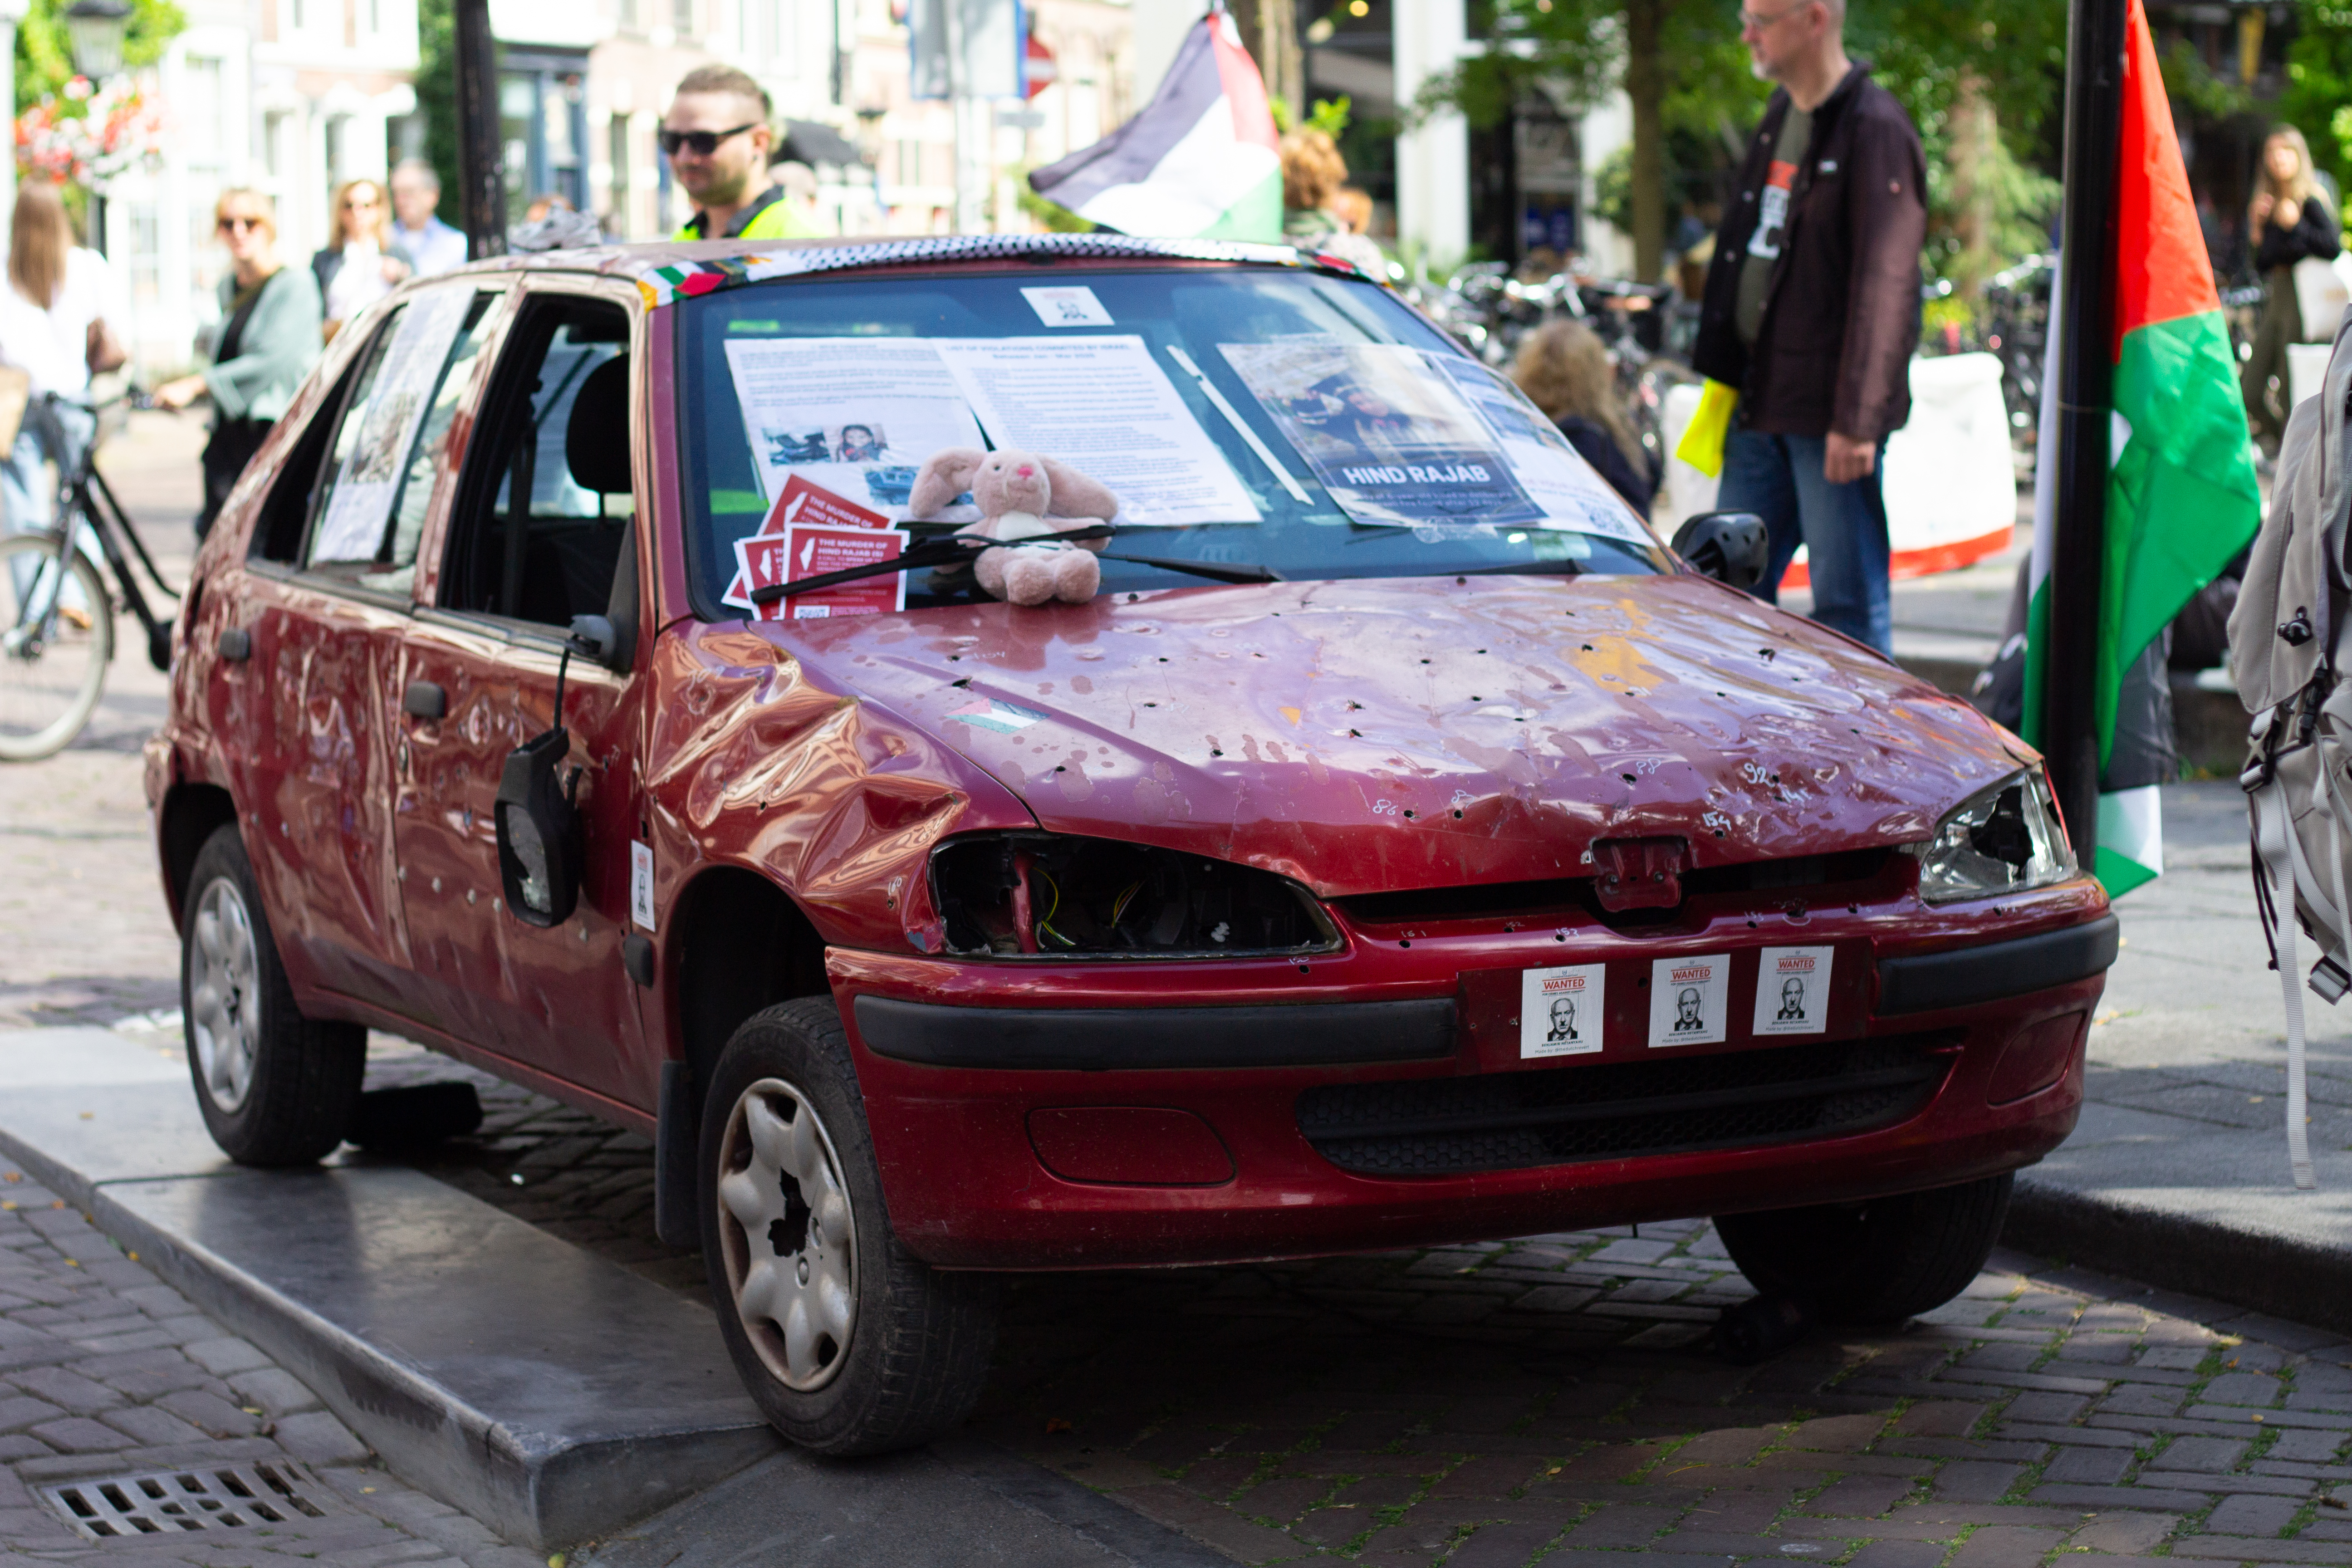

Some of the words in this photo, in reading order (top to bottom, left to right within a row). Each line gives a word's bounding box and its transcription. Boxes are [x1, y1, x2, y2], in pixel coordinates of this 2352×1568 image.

[1343, 466, 1407, 484] HIND
[1407, 464, 1490, 483] RAJAB
[810, 495, 826, 510] THE
[826, 504, 861, 524] MURDER
[819, 539, 836, 547] THE
[837, 539, 875, 548] MURDER
[818, 548, 841, 556] HIND
[842, 549, 871, 557] RAJAB
[1636, 757, 1661, 775] 88
[1744, 762, 1775, 788] 92
[1372, 799, 1398, 816] 86
[1702, 811, 1732, 831] 154
[888, 876, 903, 895] 160
[1555, 928, 1580, 939] 153
[1779, 959, 1815, 969] WANTED
[1672, 969, 1710, 980] WANTED
[1544, 978, 1585, 990] WANTED
